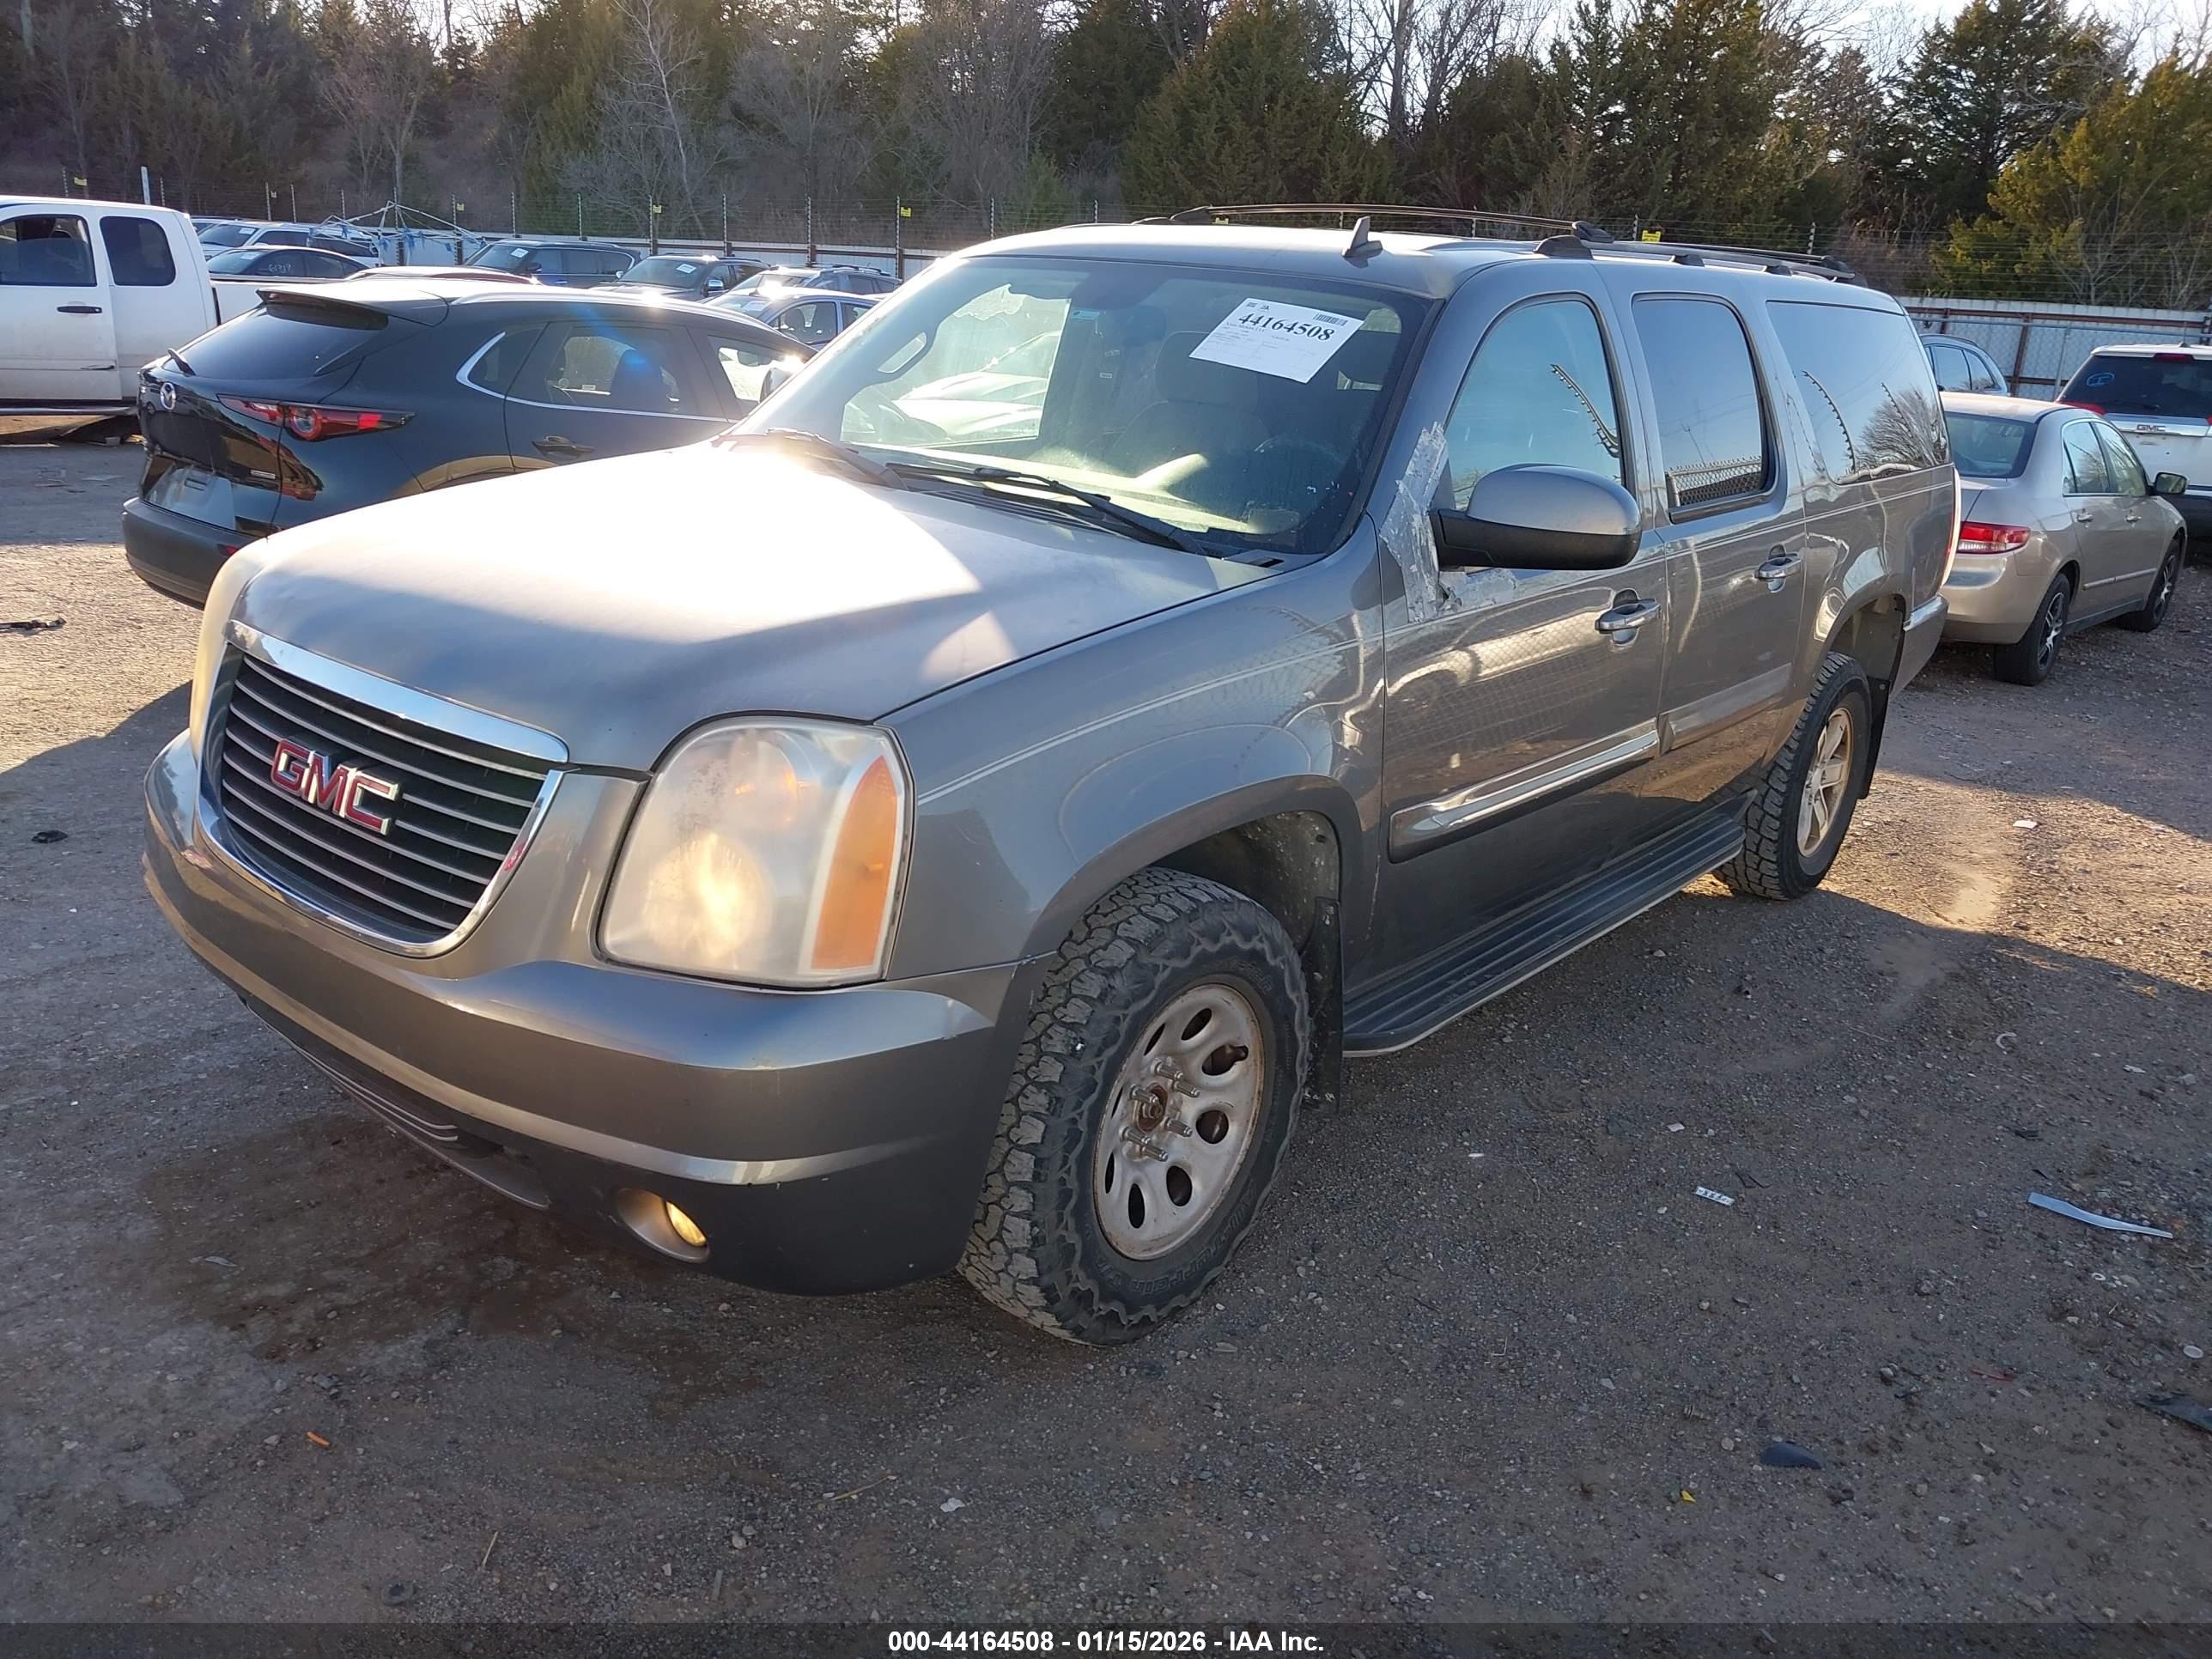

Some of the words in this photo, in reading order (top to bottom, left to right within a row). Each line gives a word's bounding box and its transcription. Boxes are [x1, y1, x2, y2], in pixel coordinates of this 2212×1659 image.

[1237, 312, 1336, 342] 44164508
[2136, 423, 2166, 433] GMC
[270, 738, 400, 836] GMC
